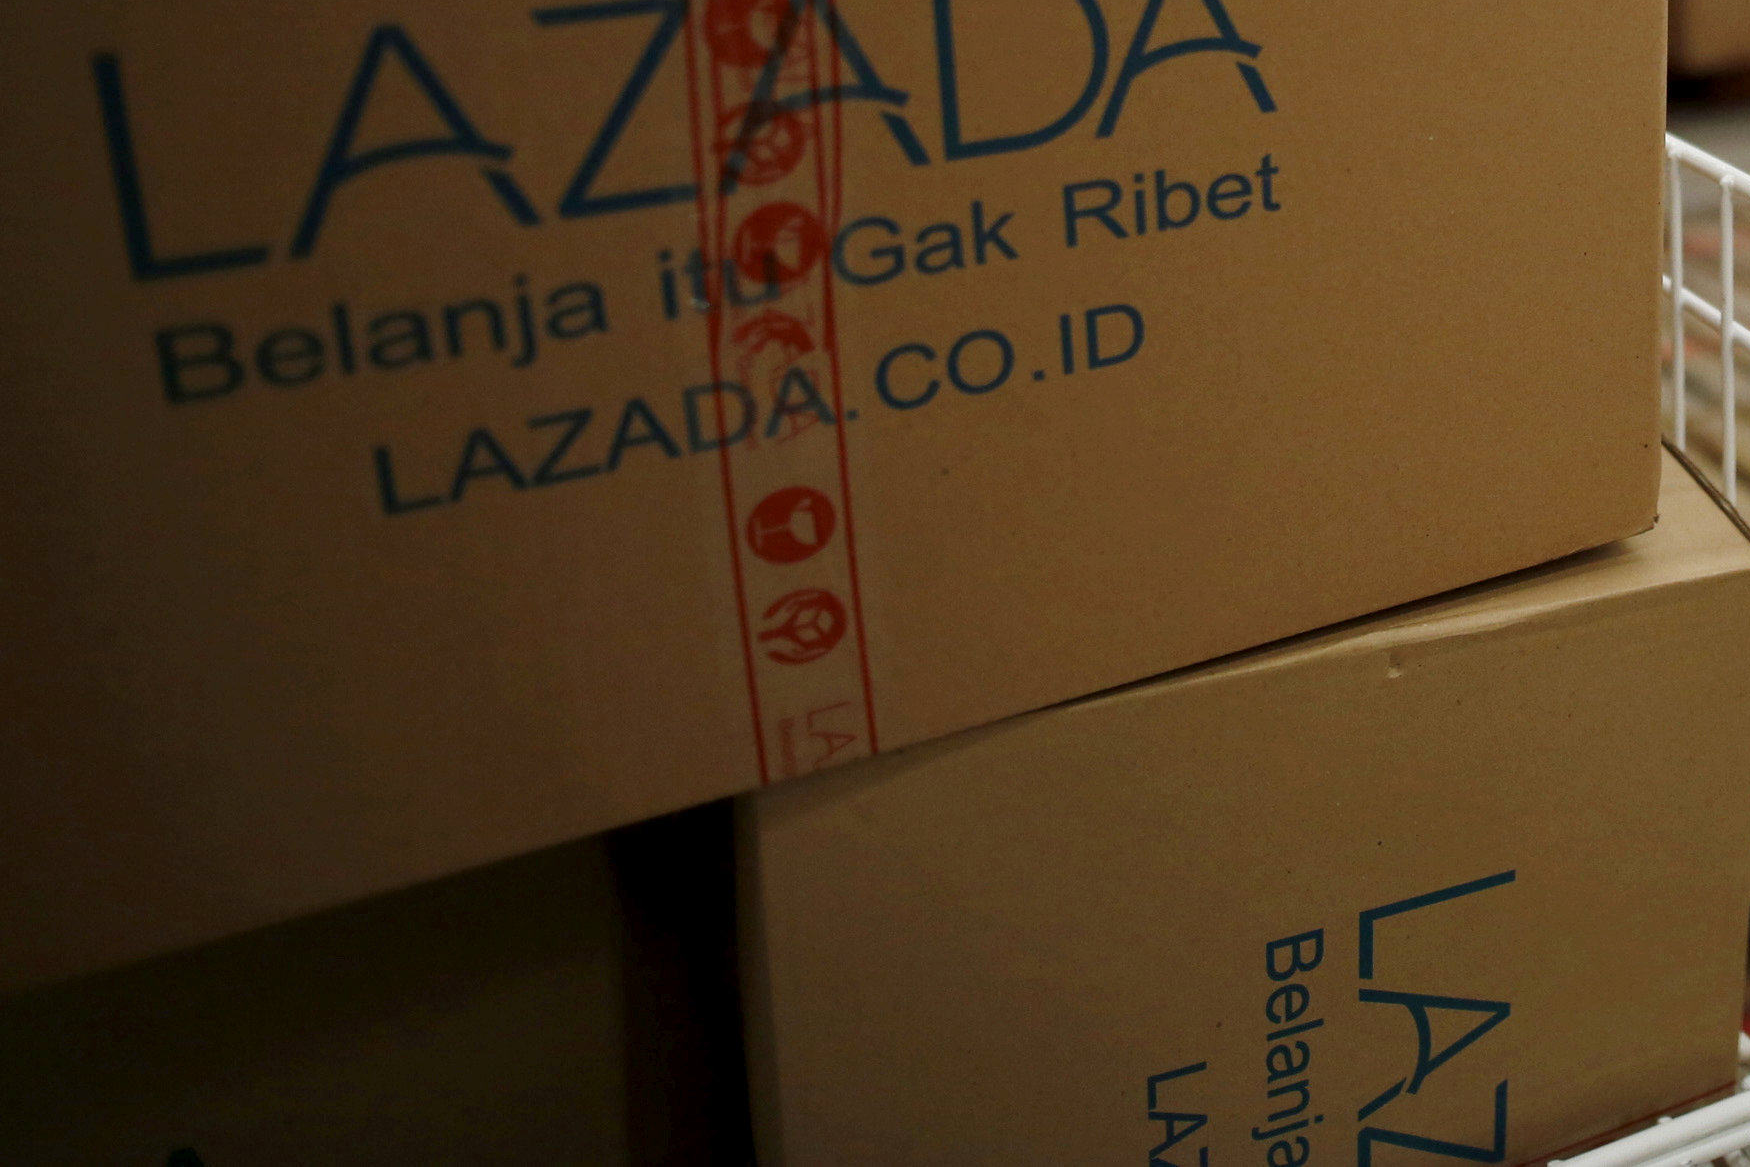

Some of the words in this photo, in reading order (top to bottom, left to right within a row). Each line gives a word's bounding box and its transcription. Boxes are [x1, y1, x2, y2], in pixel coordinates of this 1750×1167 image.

[153, 274, 608, 405] Belanja
[658, 246, 782, 320] itu
[829, 200, 1019, 287] Gak
[1063, 153, 1282, 249] Ribet
[372, 302, 1146, 516] LAZADA.CO.ID
